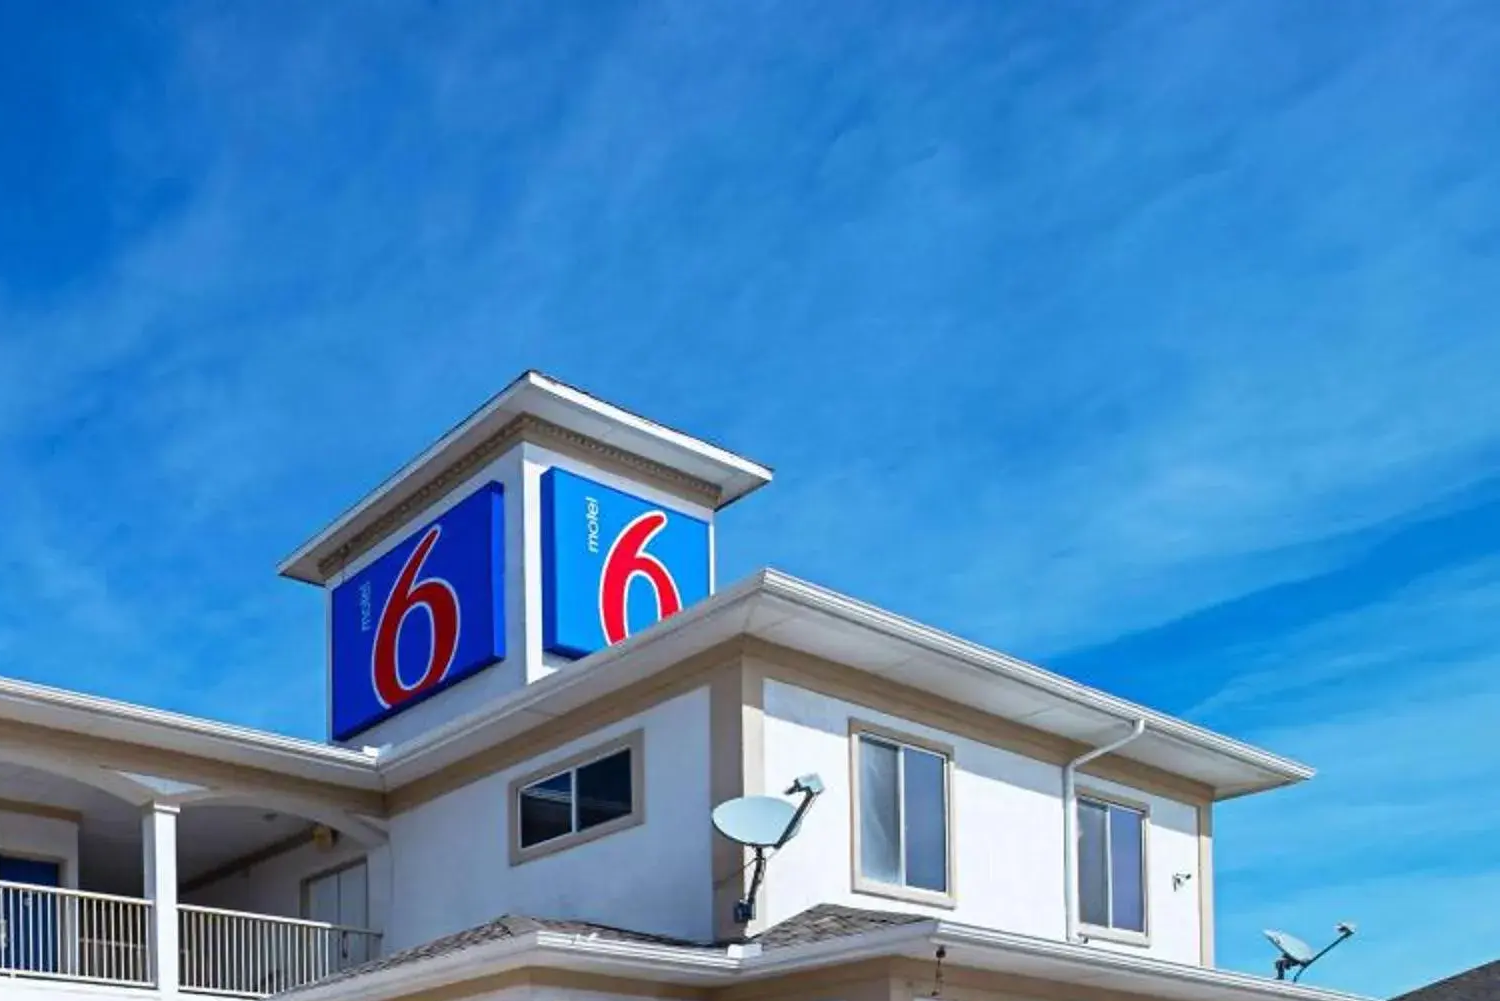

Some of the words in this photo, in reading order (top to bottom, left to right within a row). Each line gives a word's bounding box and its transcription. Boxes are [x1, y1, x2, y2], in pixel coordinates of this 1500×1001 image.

[585, 496, 599, 554] motel
[599, 510, 683, 647] 6
[371, 523, 461, 709] 6
